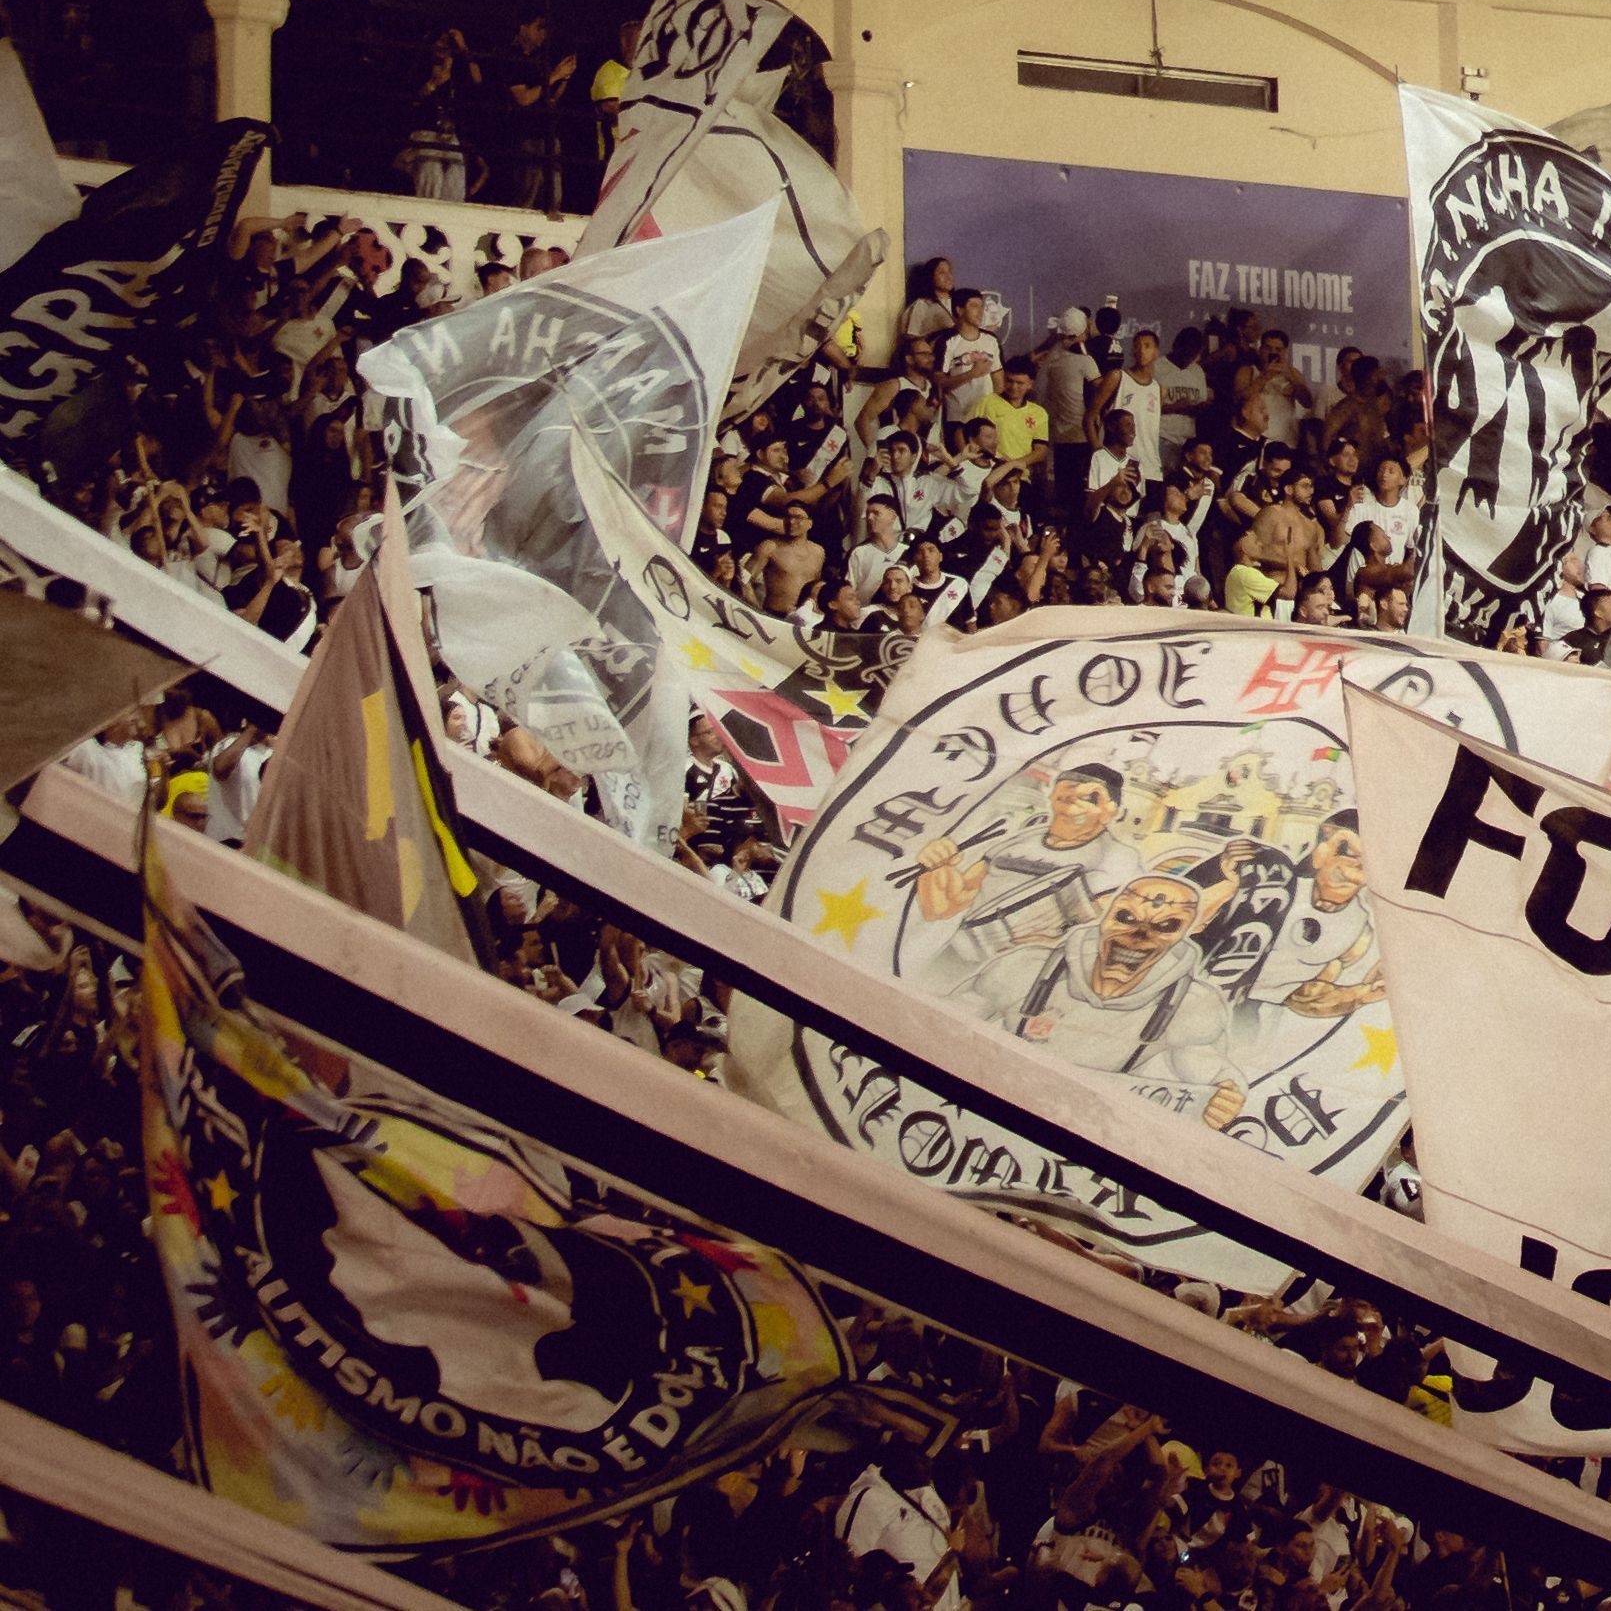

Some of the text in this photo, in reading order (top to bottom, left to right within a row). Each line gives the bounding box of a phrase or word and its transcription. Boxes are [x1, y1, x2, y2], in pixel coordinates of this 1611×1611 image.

[1188, 259, 1230, 302] FAZ
[1235, 265, 1279, 307] TEU
[234, 1244, 467, 1440] AUTISMO
[477, 1425, 600, 1475] NÃO
[602, 1425, 648, 1473] É
